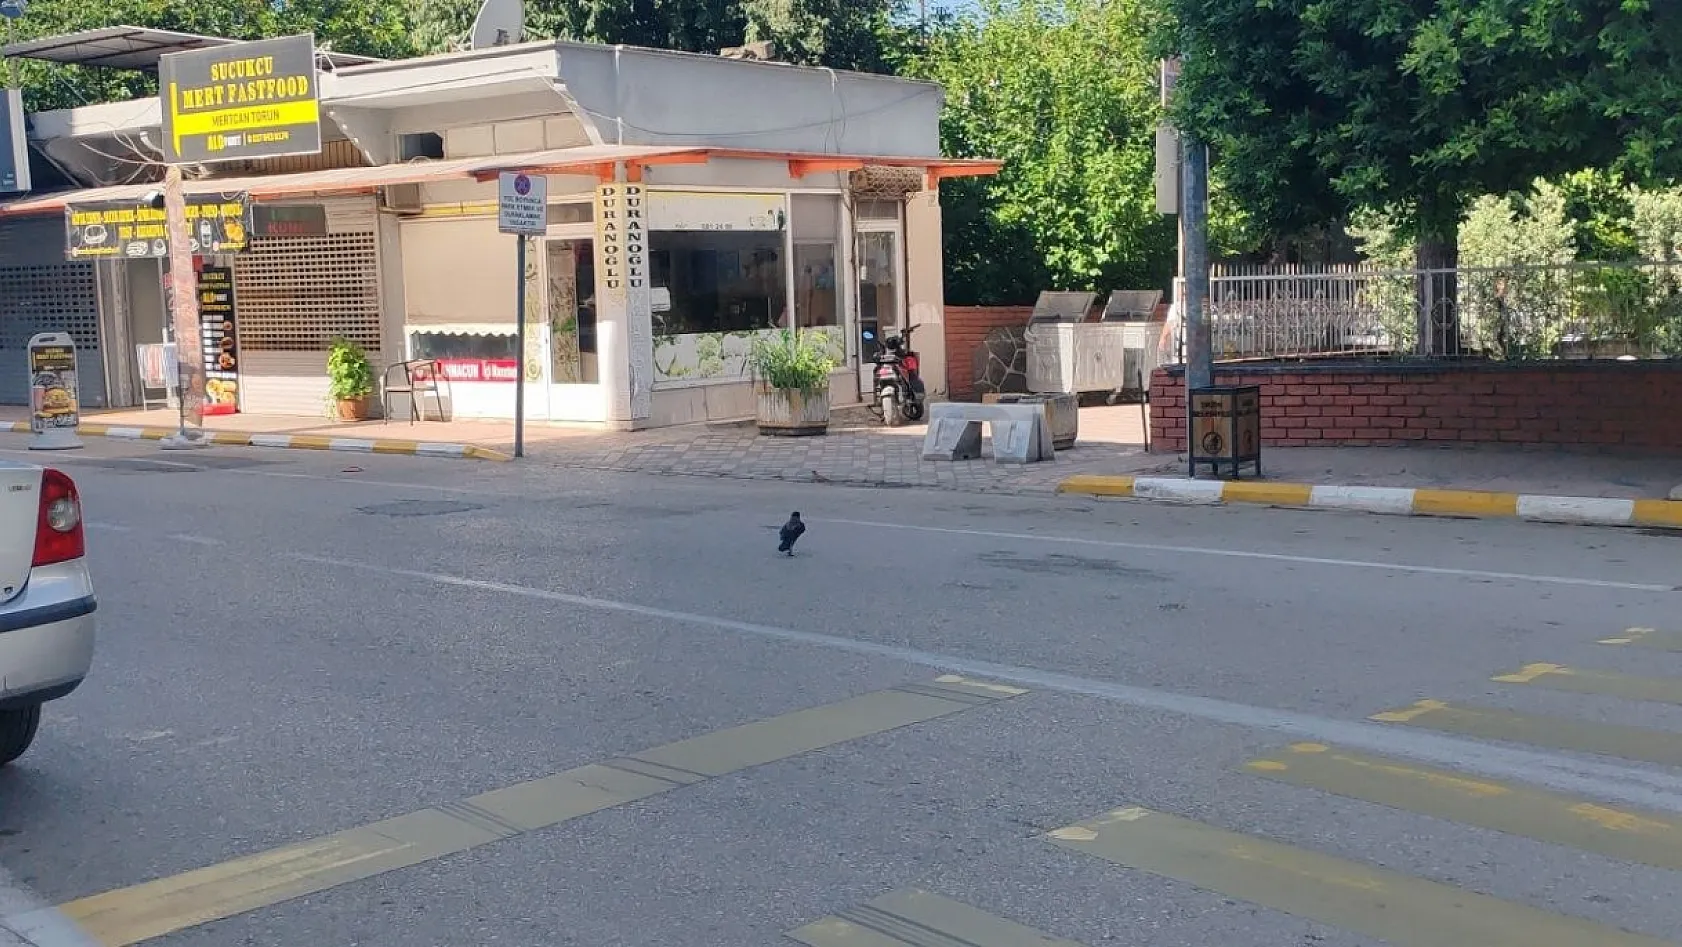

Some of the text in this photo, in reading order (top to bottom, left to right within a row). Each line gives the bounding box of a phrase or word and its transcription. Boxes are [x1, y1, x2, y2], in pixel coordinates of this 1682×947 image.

[210, 56, 273, 81] SUCUKCU
[182, 75, 308, 108] MERT FASTFOOD
